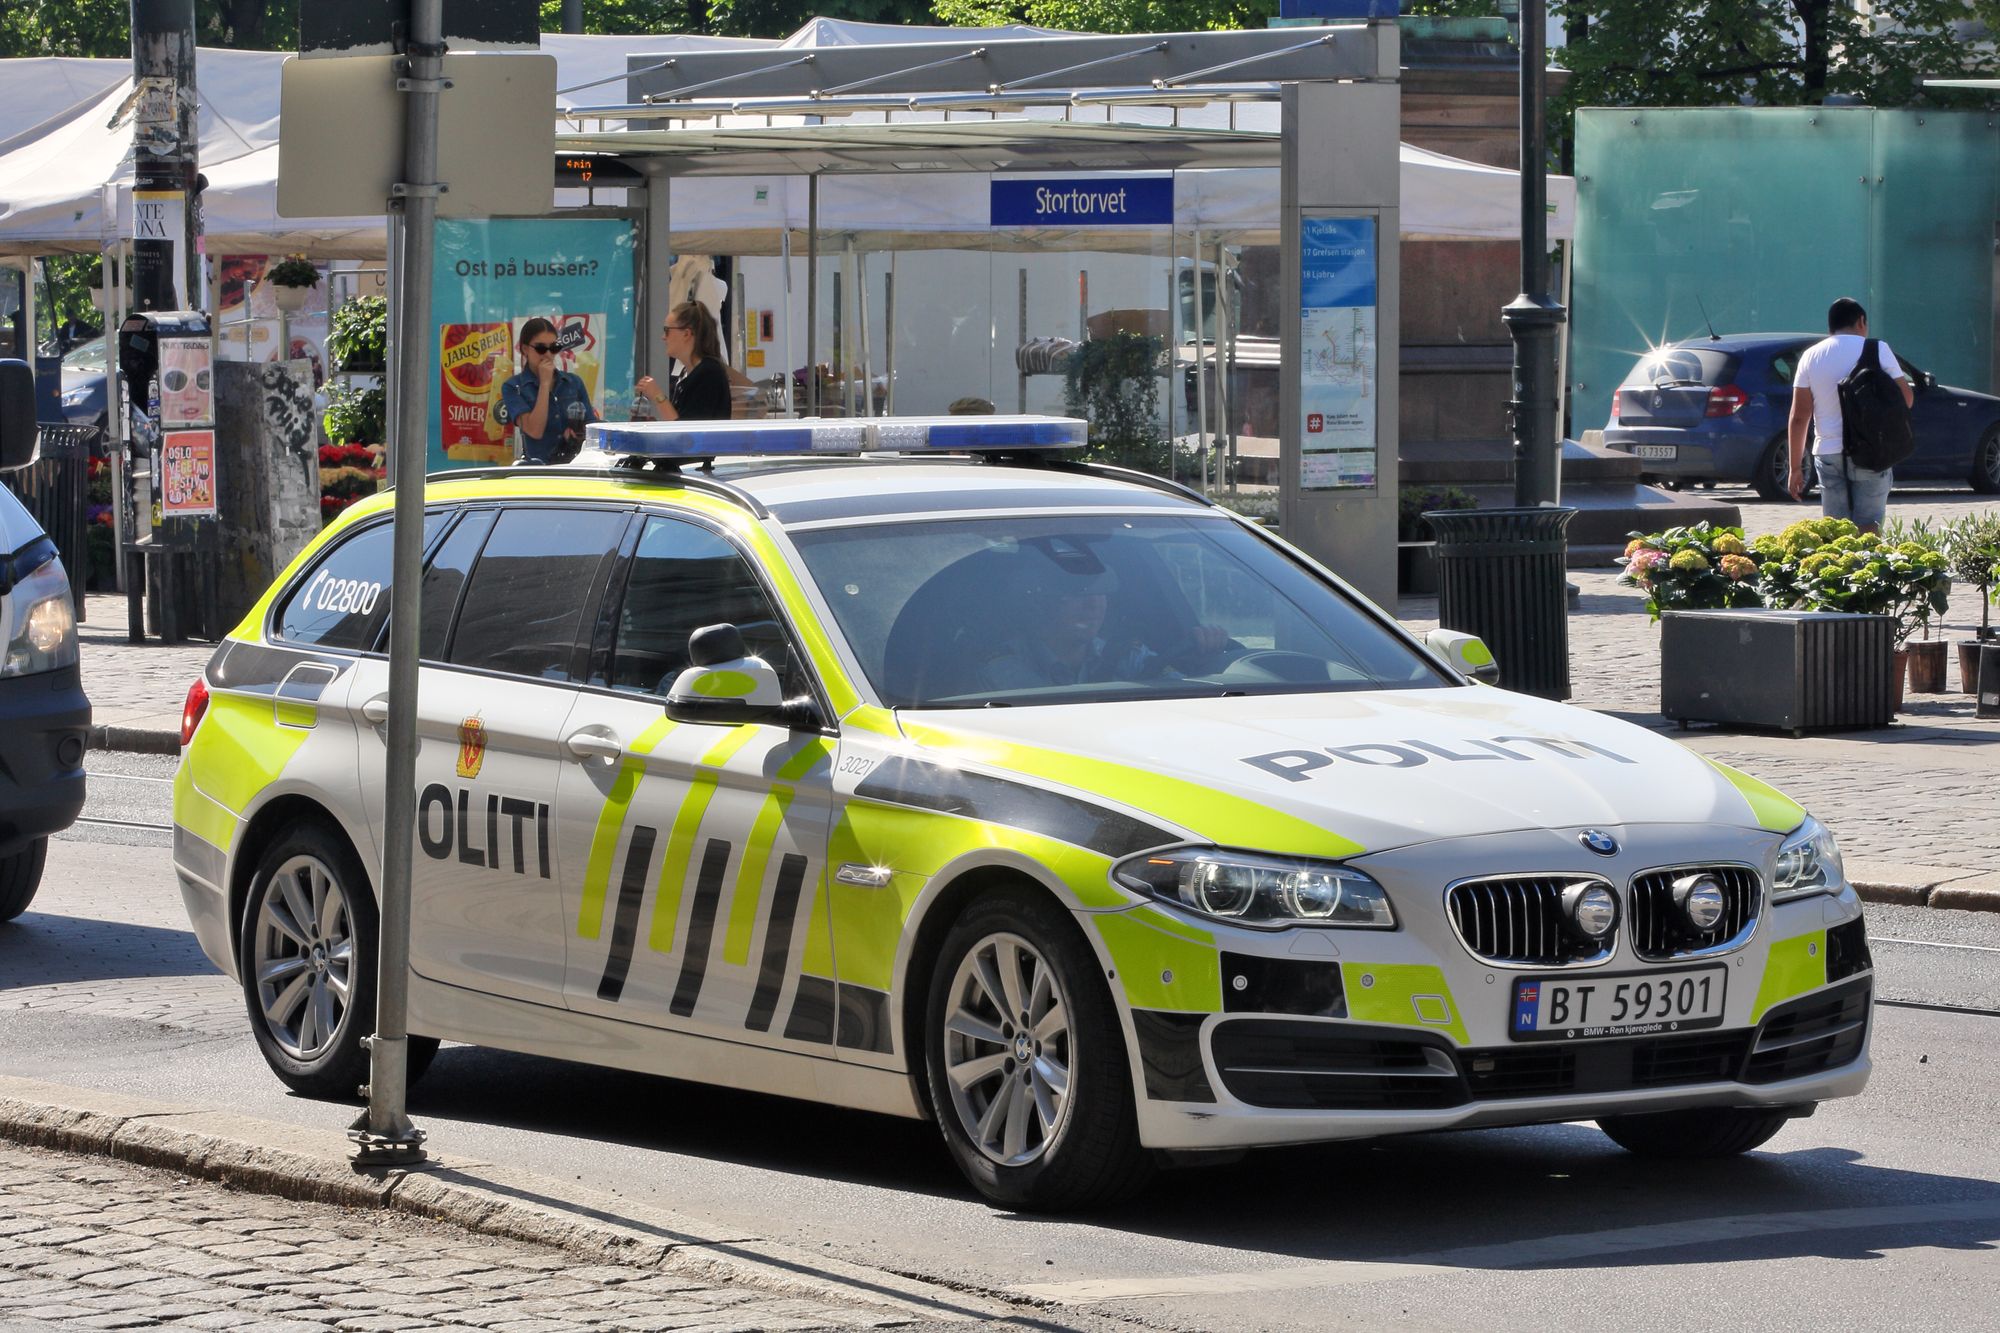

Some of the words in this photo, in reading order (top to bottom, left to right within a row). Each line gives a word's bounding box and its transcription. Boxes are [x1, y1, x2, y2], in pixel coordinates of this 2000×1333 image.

[566, 160, 572, 168] 4
[574, 160, 591, 168] min
[582, 172, 592, 181] 17
[1036, 187, 1126, 214] Stortorvet
[1303, 248, 1311, 256] 17
[1312, 248, 1339, 256] Grefsen
[1341, 247, 1366, 257] stasjon
[455, 260, 487, 276] Ost
[494, 257, 517, 279] på
[524, 260, 599, 276] bussen?
[1303, 271, 1311, 279] 18
[554, 330, 581, 346] EGIA
[444, 329, 507, 368] JARLSBERG
[448, 405, 485, 423] STAVER
[168, 446, 192, 459] OSLO
[1637, 447, 1647, 457] BS
[1649, 447, 1674, 457] 73557
[168, 475, 209, 495] FESTIVAL
[168, 488, 192, 504] 2018
[317, 577, 381, 615] 02800
[840, 755, 874, 776] 3021
[1239, 735, 1639, 783] POLITI
[413, 782, 551, 880] OLITI
[1550, 986, 1595, 1025] BT
[1611, 976, 1711, 1021] 59301
[1521, 1013, 1532, 1025] N
[1583, 1027, 1604, 1036] BMW
[1609, 1025, 1624, 1035] Ren
[1625, 1023, 1662, 1035] kjøreglede
